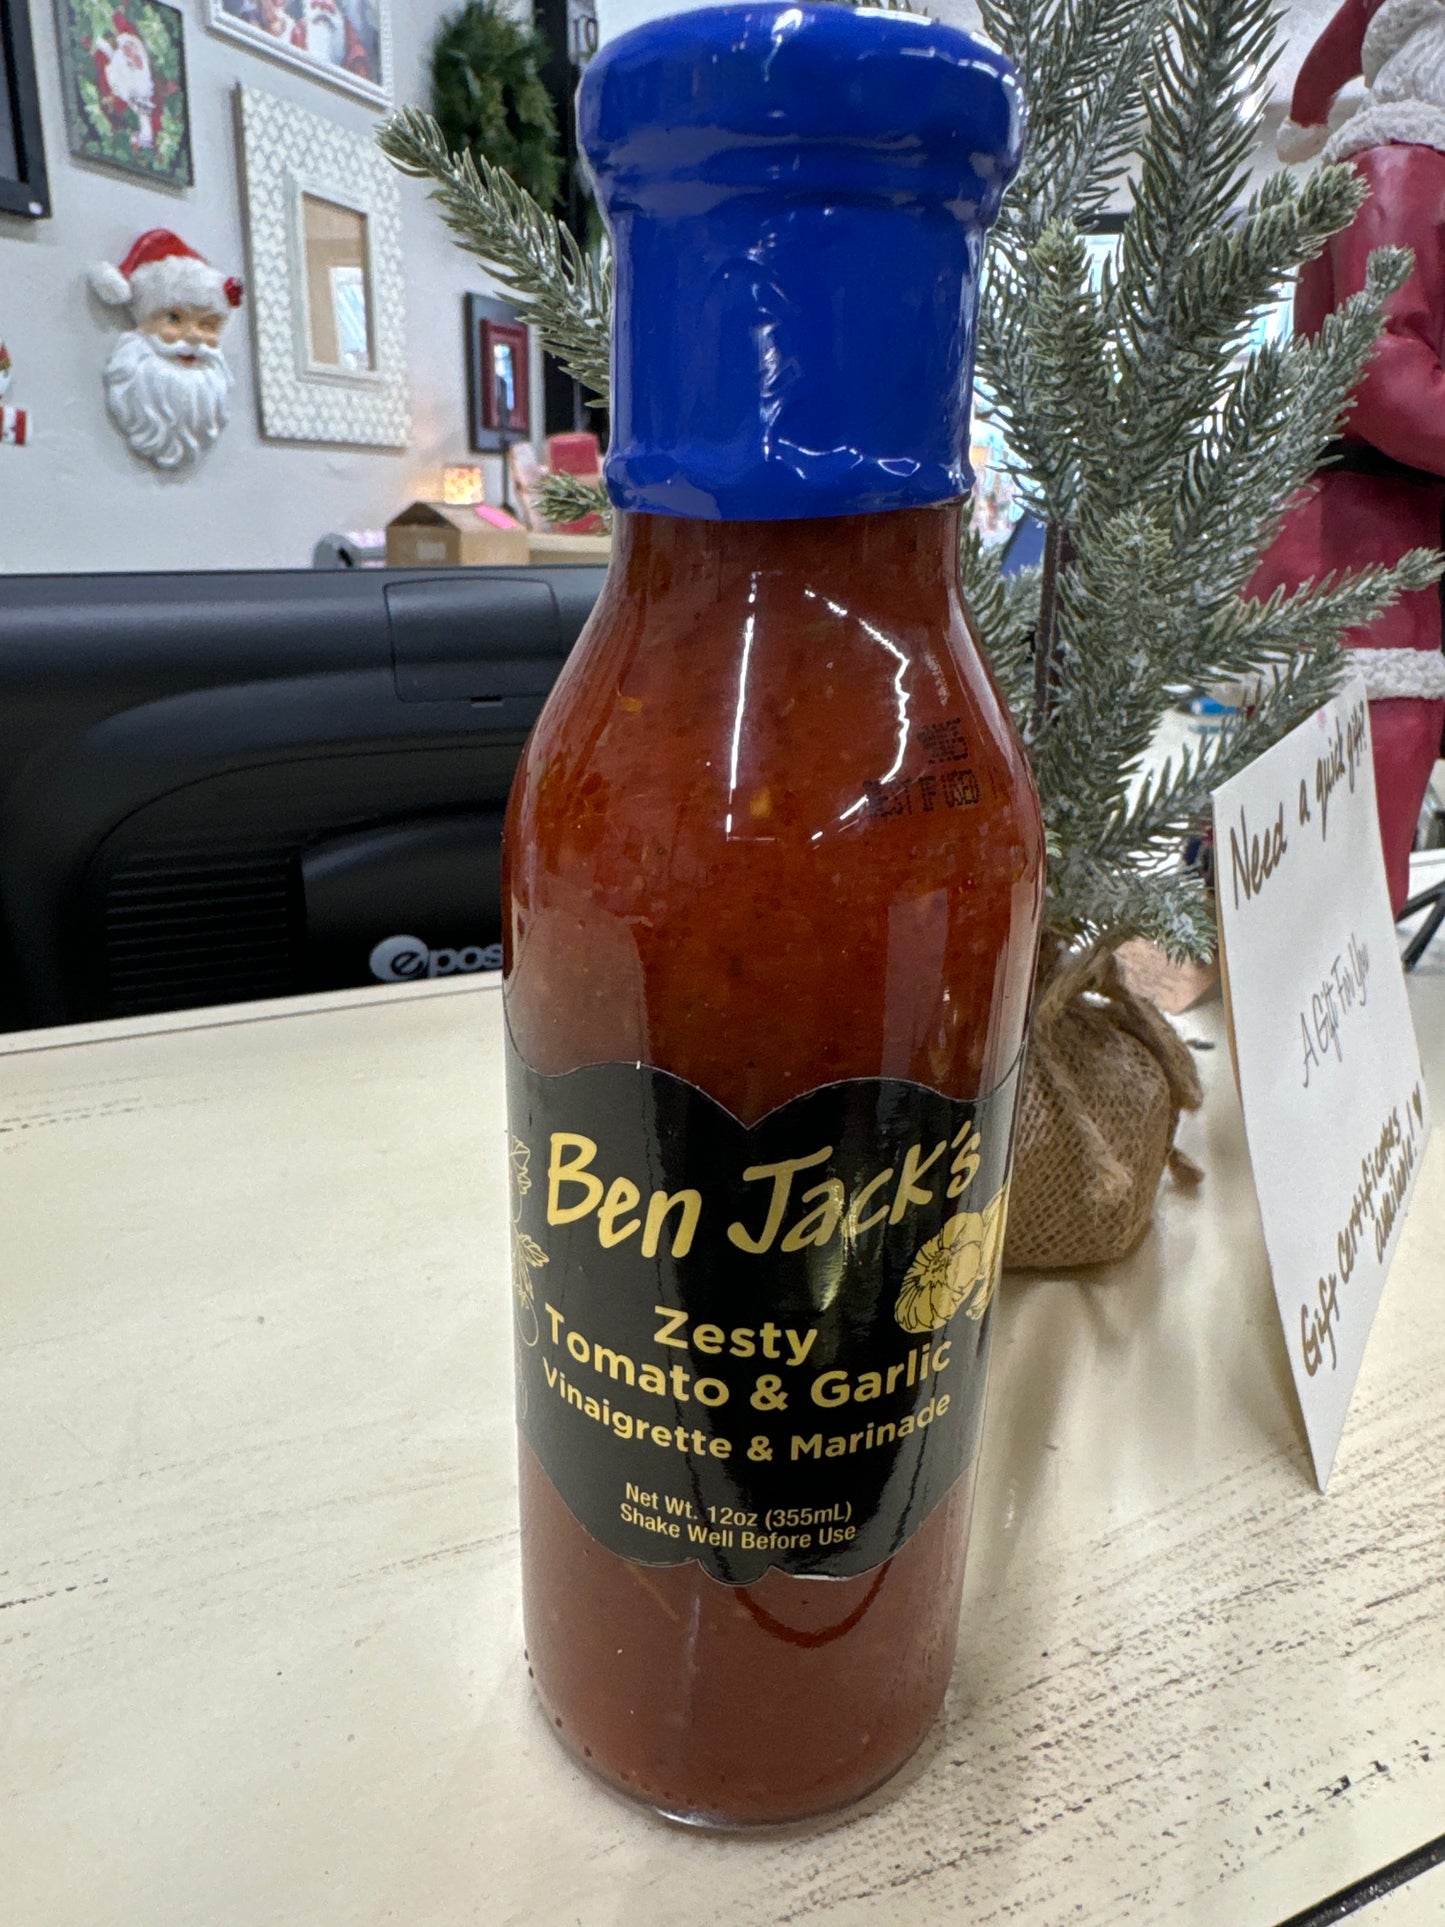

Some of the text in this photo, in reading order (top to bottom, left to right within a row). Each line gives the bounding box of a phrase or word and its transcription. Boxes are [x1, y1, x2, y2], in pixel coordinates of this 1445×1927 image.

[1230, 802, 1287, 910] Need
[1299, 778, 1310, 826] a
[1316, 714, 1345, 842] quick
[1300, 1012, 1319, 1088] A
[546, 1121, 981, 1258] Ben Jack's
[544, 1302, 952, 1411] Tomato & Garlic
[653, 1305, 818, 1365] Zesty
[1301, 1273, 1339, 1377] Gift
[543, 1358, 951, 1461] Vinaigrette & Marinade
[620, 1503, 857, 1550] Shake Well Before Use
[625, 1482, 852, 1530] Net Wt. 12oz (355mL)
